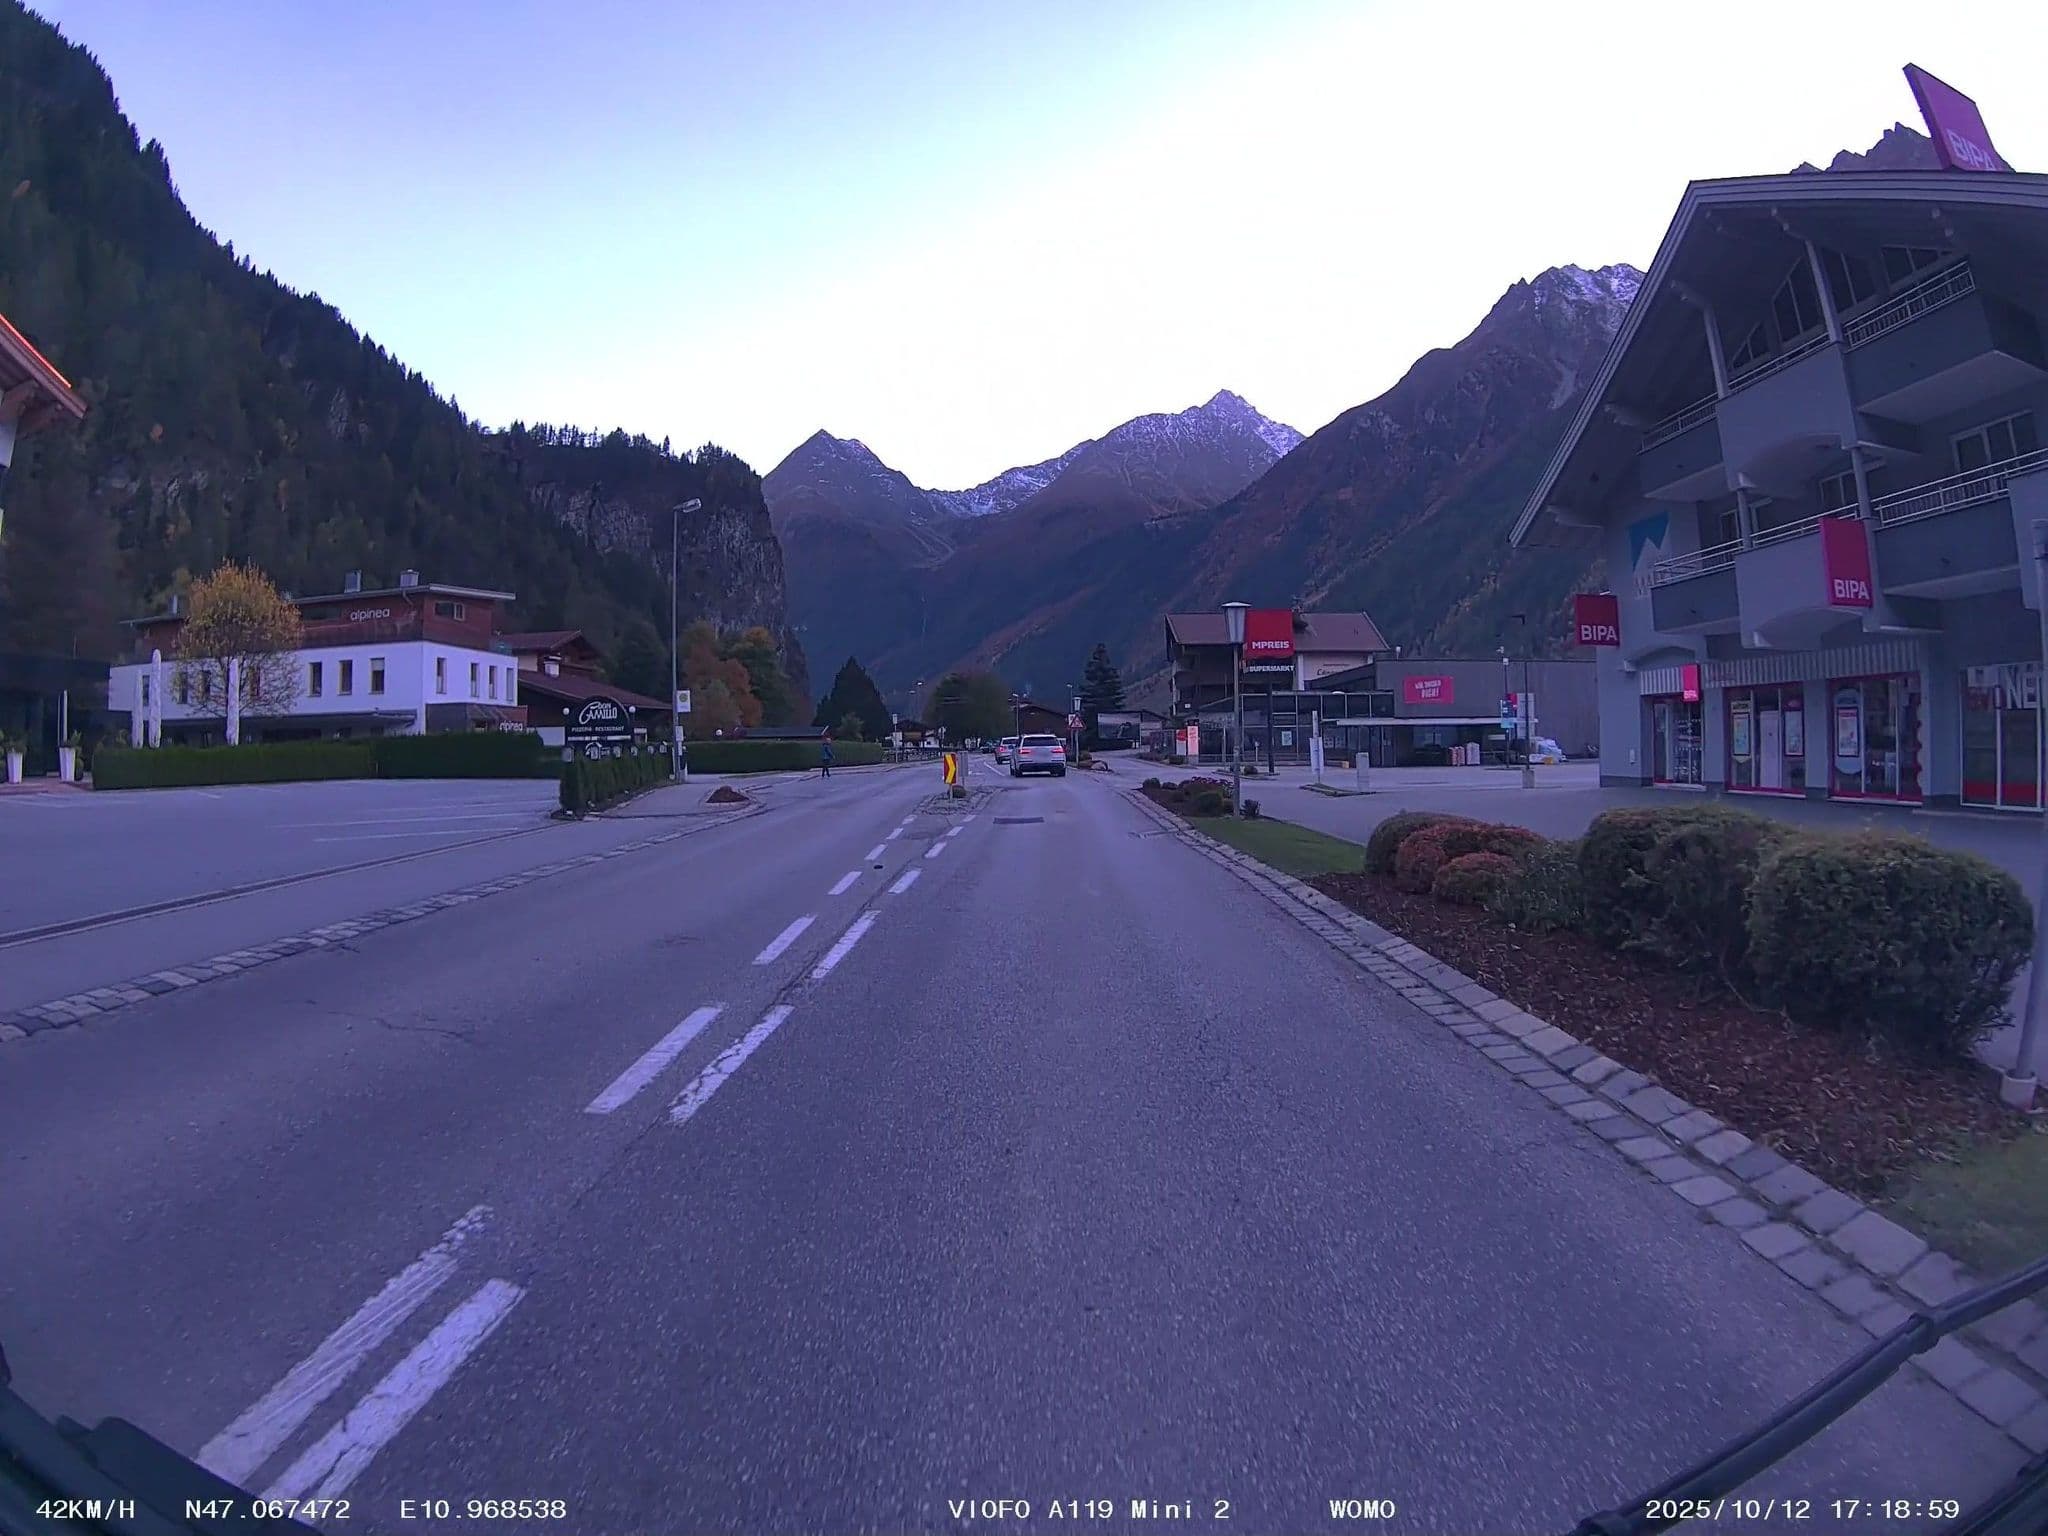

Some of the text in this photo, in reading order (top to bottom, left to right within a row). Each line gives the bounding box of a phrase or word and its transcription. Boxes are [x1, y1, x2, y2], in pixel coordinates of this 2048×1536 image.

[1945, 128, 1998, 170] BIPA
[1834, 579, 1870, 600] BIPA
[350, 608, 391, 622] alpinea
[1581, 624, 1617, 641] BIPA
[1252, 641, 1290, 649] MPREIS
[1249, 665, 1295, 673] SUPERMARKT
[579, 701, 618, 725] CAMILLO
